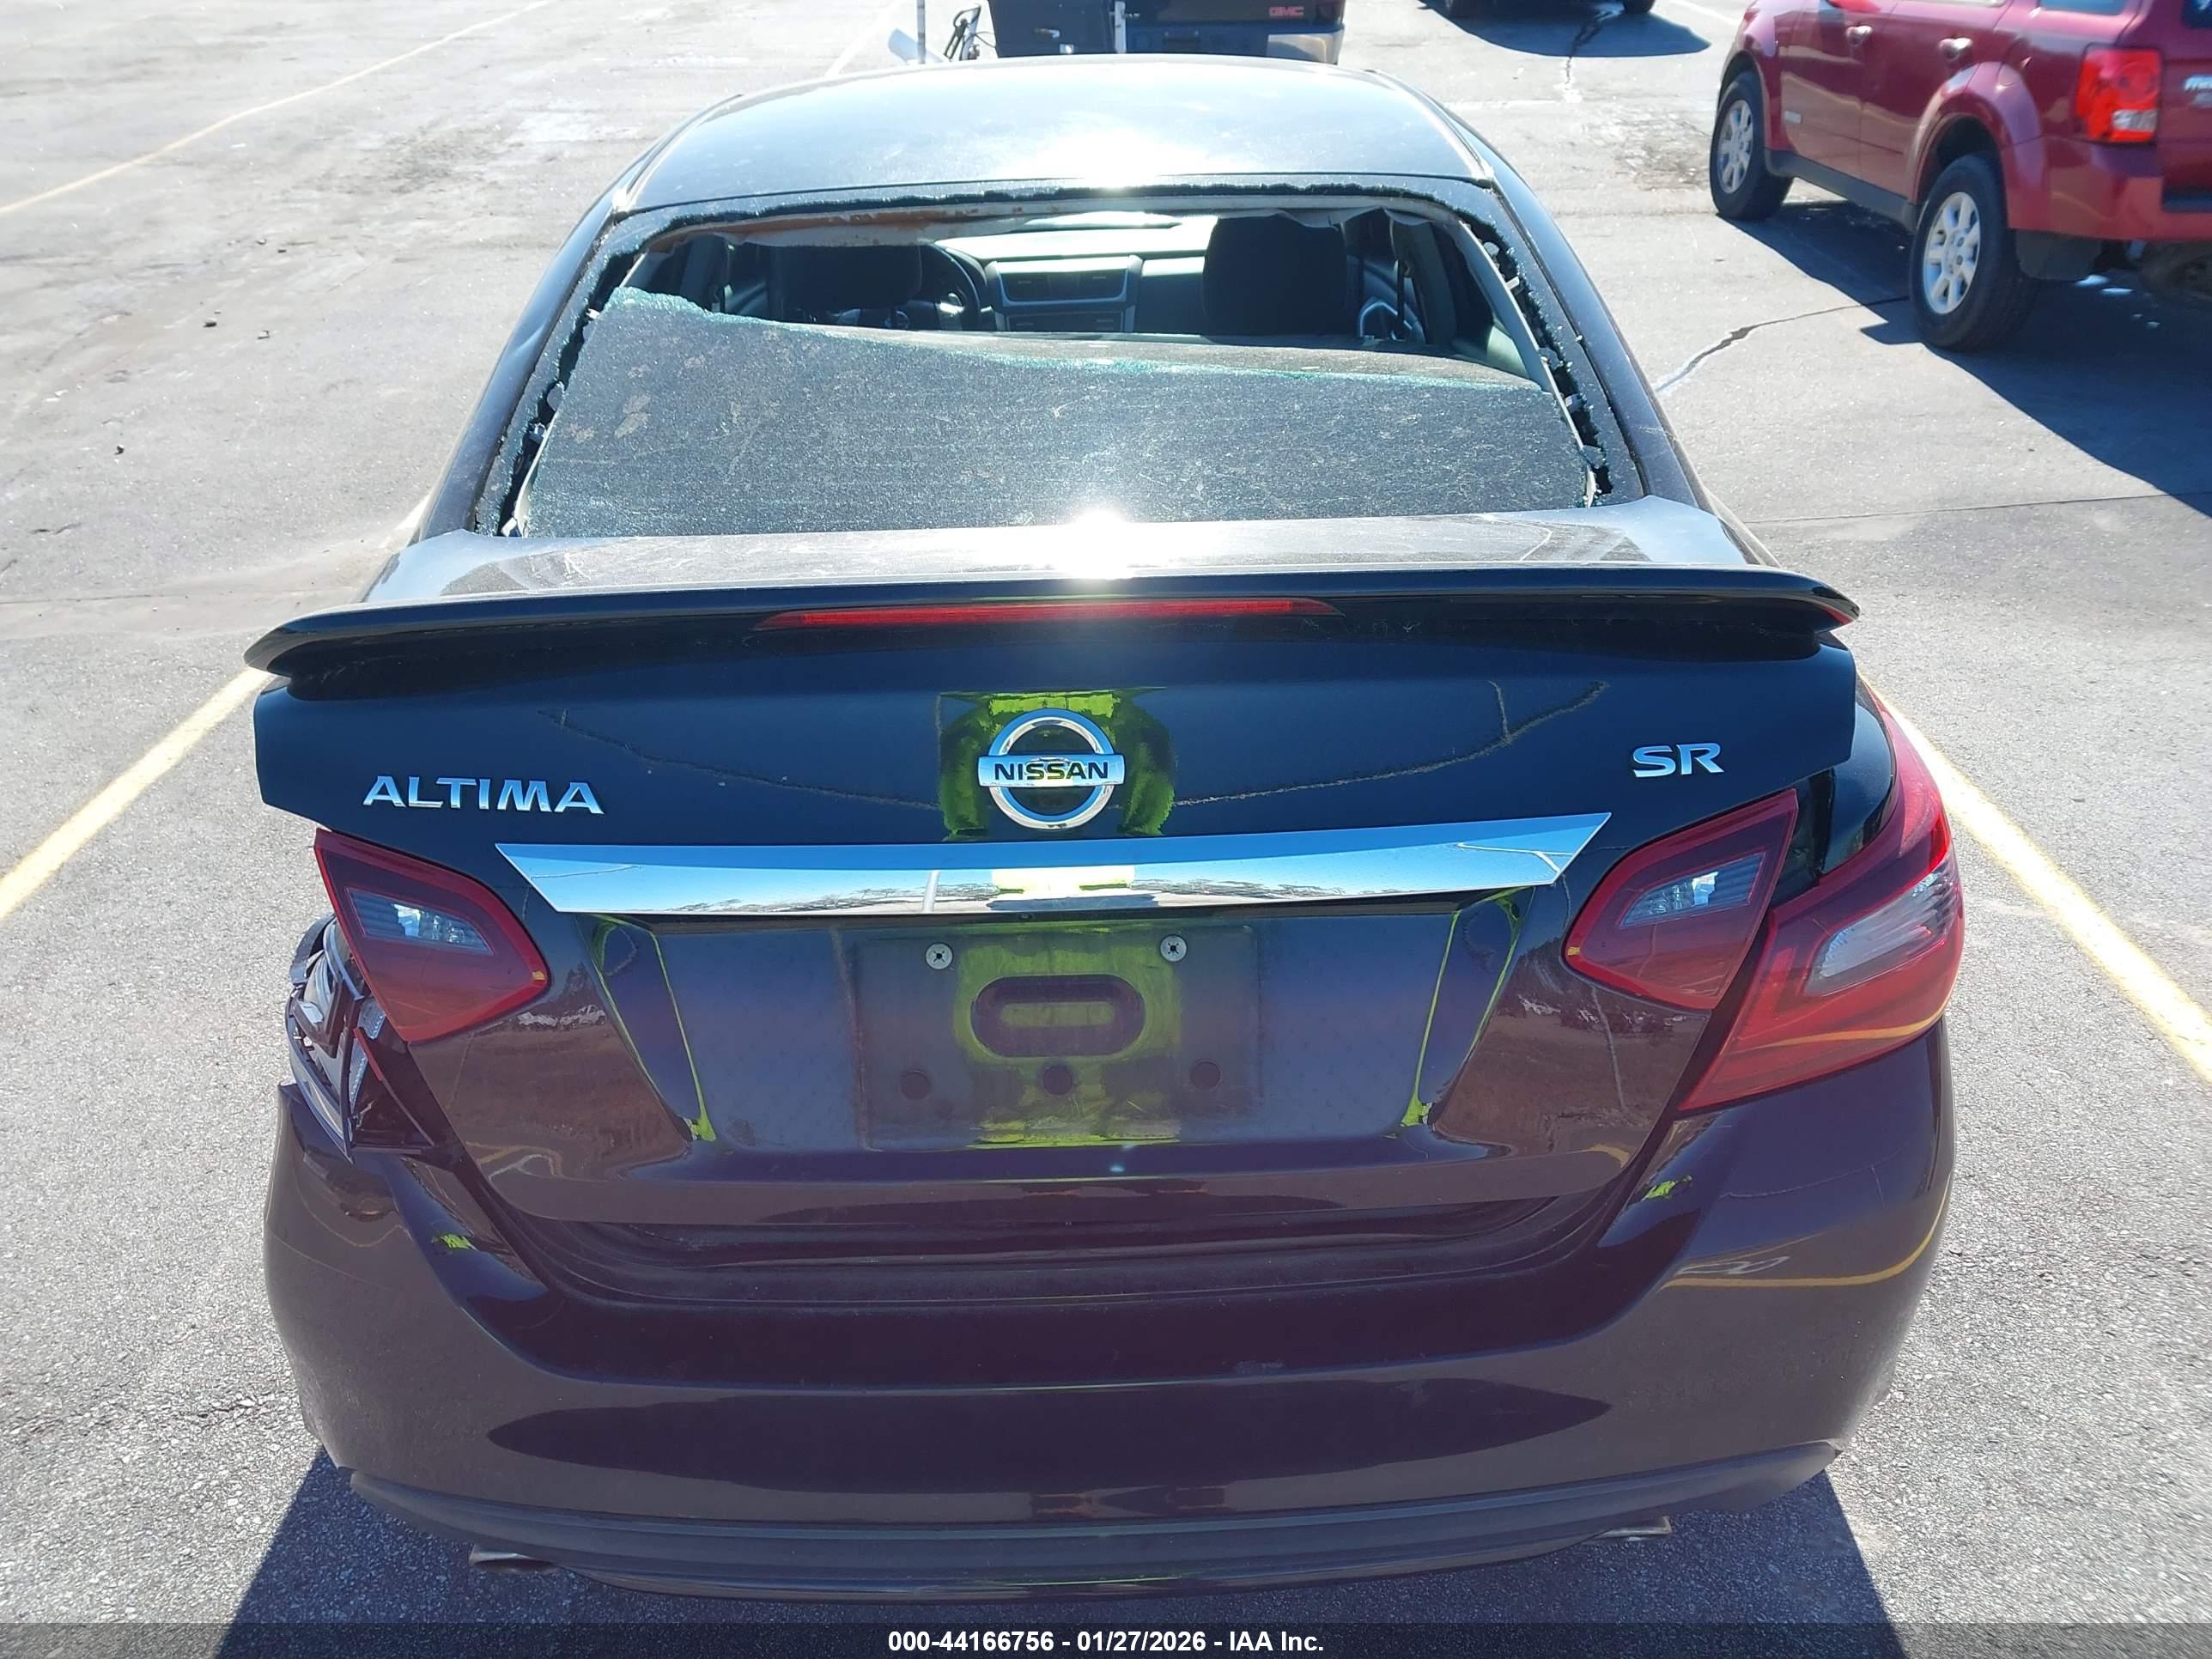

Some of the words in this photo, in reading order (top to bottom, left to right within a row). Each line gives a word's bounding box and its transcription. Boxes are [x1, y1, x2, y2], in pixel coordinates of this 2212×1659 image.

[1268, 6, 1305, 17] GMC
[994, 761, 1109, 781] NISSAN
[1632, 742, 1725, 778] SR
[362, 775, 605, 815] ALTIMA
